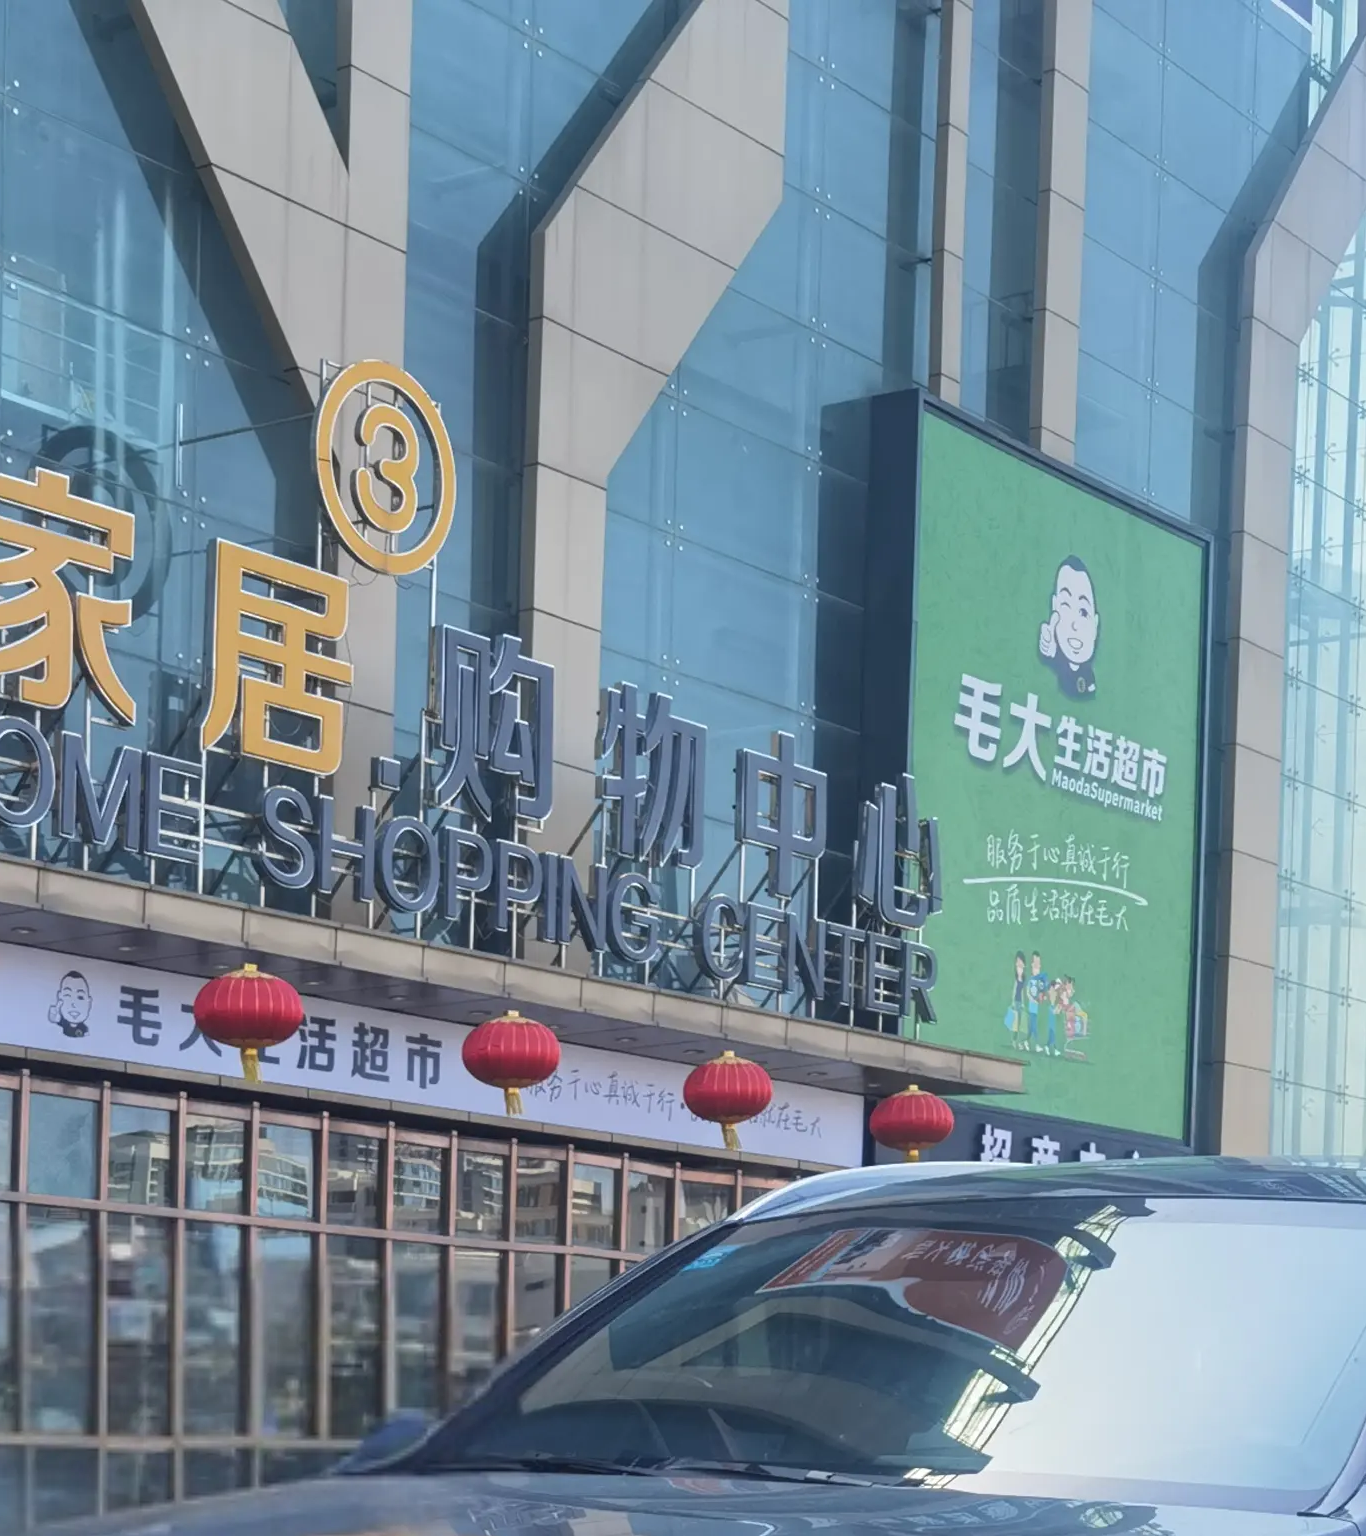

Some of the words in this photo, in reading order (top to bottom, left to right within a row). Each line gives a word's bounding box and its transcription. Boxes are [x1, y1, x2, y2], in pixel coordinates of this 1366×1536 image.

[435, 624, 942, 929] 购物中心
[954, 672, 1168, 798] 毛大生活超市
[1051, 768, 1164, 822] MaodaSupermarket
[260, 785, 660, 963] SHOPPING
[695, 893, 936, 1024] CENTER
[987, 829, 1131, 889] 服务于心真诚于行
[987, 884, 1129, 931] 品质生活就在毛大
